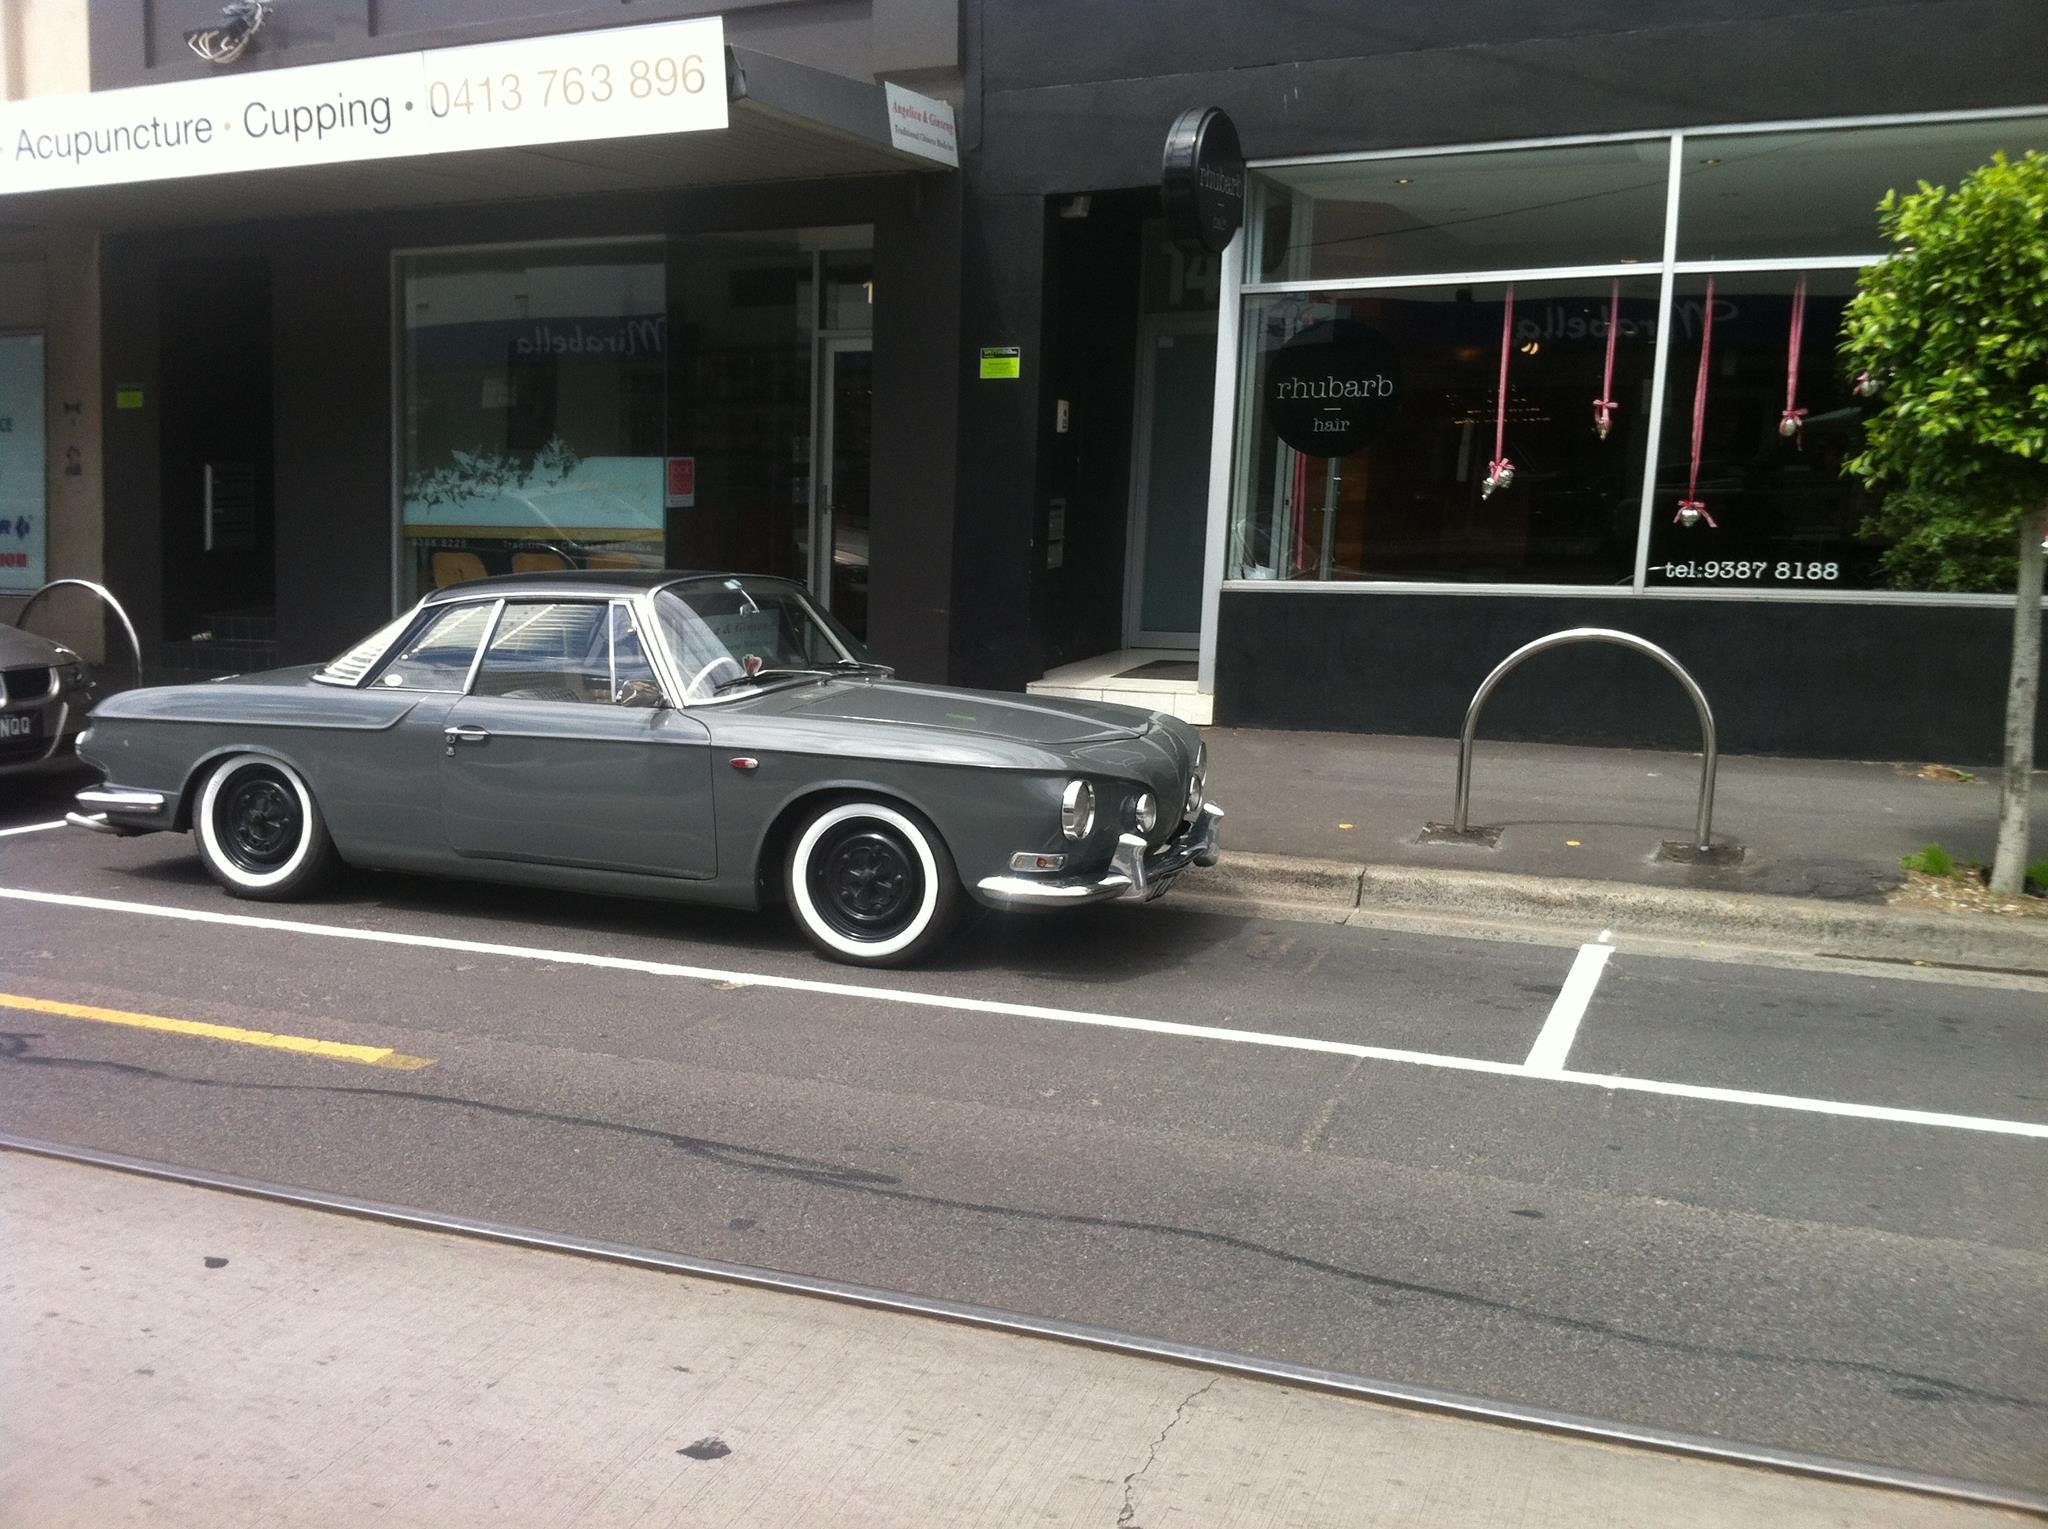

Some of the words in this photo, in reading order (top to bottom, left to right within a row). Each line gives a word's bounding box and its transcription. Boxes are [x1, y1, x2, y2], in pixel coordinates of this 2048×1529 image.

[15, 115, 214, 166] Acupuncture
[242, 91, 392, 145] Cupping
[428, 73, 524, 119] 0413
[536, 63, 615, 109] 763
[628, 54, 707, 101] 896
[1276, 374, 1394, 400] rhubarb
[1312, 417, 1351, 433] hair
[1665, 560, 1768, 579] tel:9387
[1774, 561, 1840, 581] 8188
